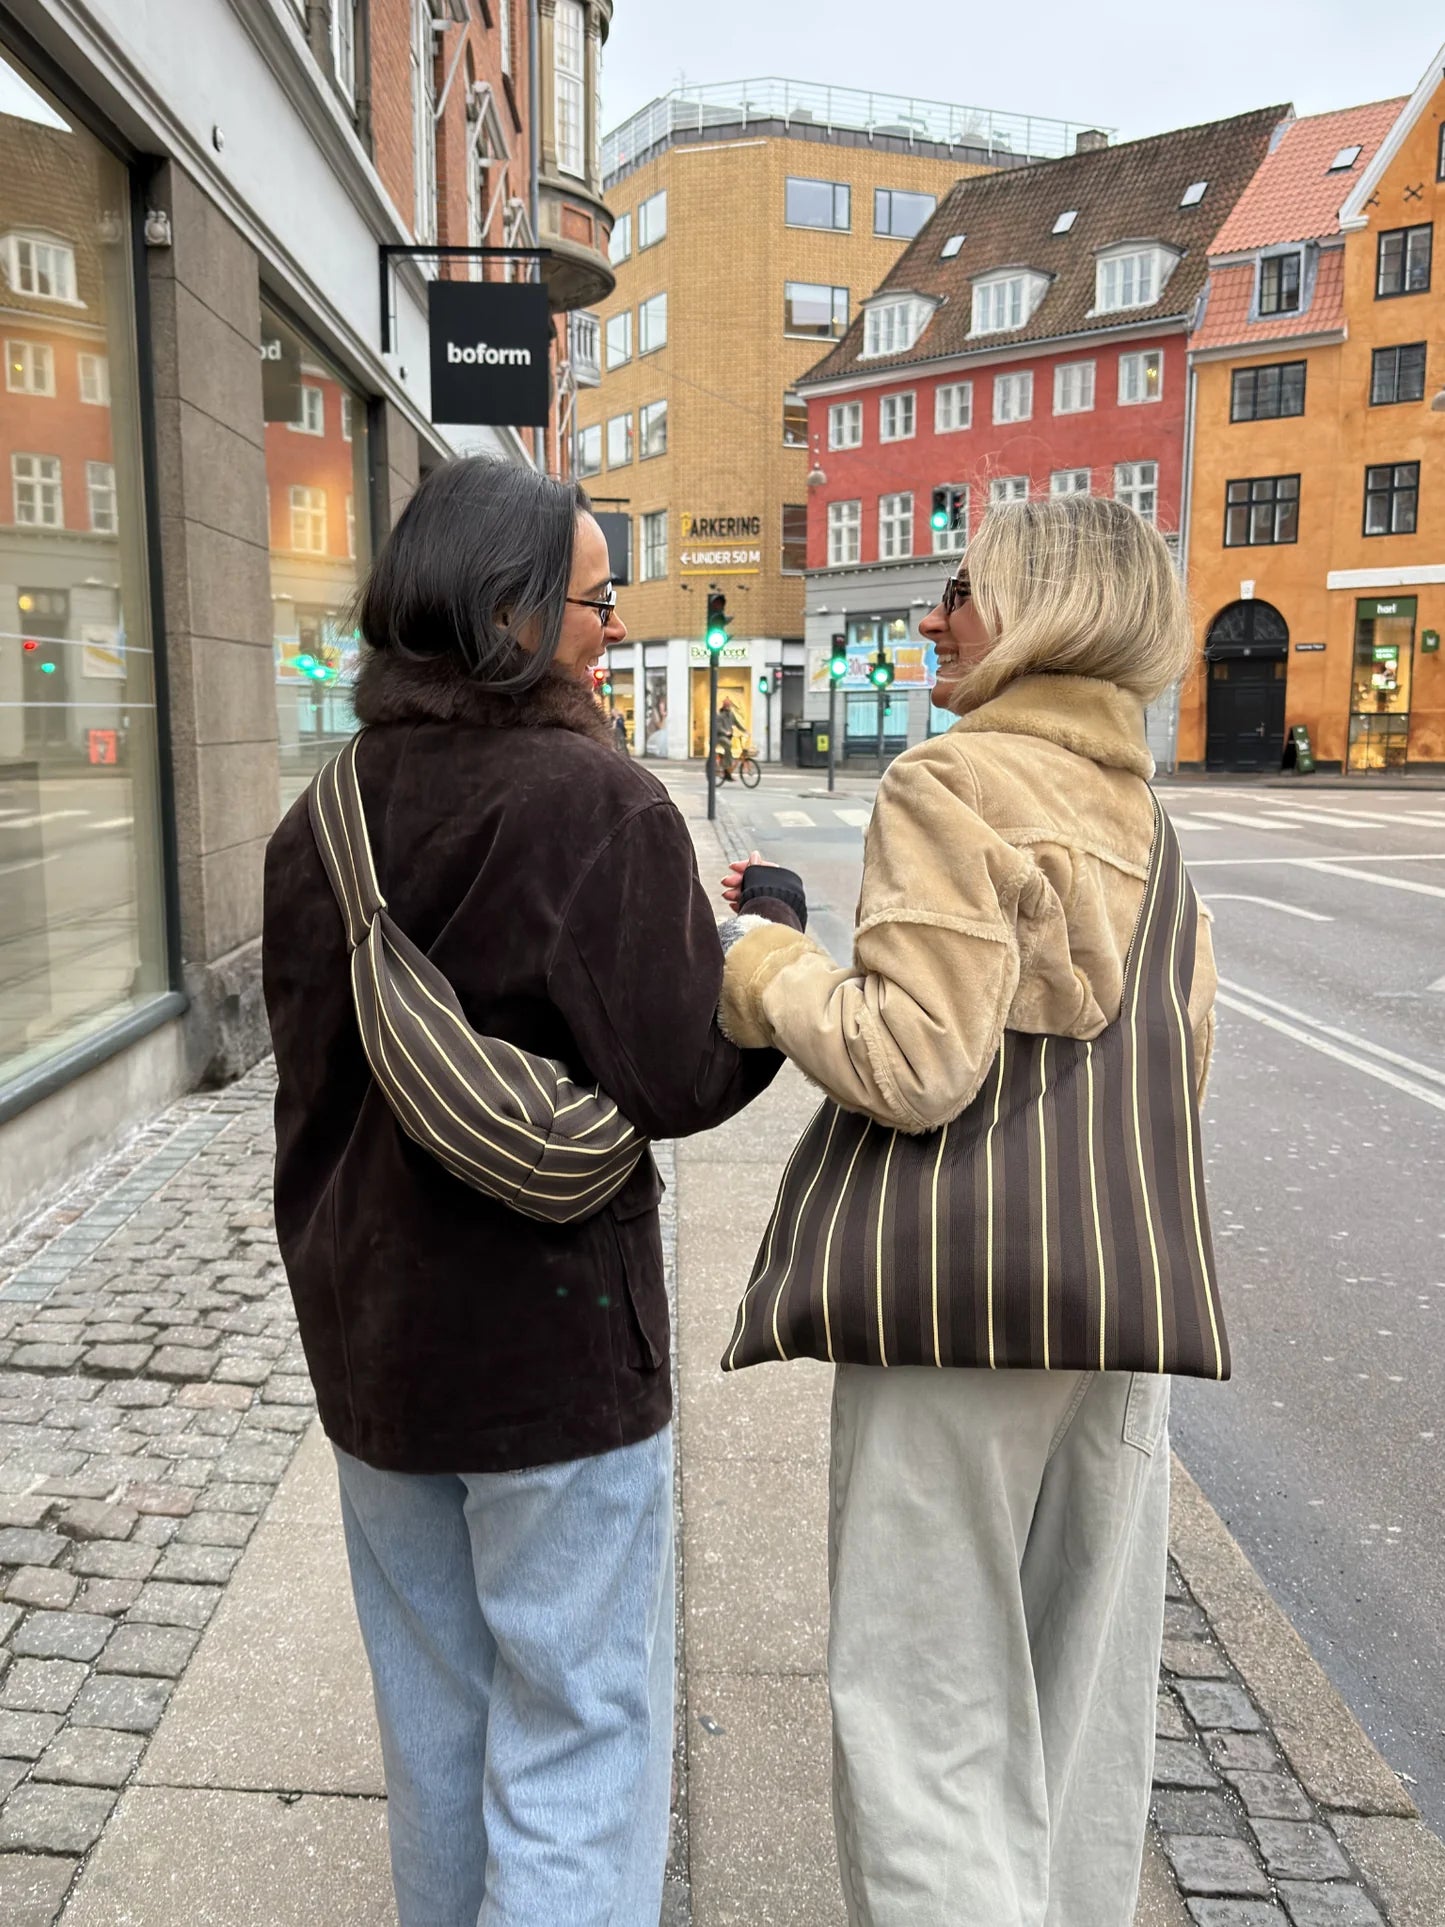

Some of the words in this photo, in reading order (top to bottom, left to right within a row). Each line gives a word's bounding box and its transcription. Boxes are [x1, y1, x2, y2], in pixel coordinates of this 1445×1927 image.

[447, 341, 531, 365] boform
[680, 512, 760, 537] PARKERING
[691, 551, 731, 564] UNDER
[732, 550, 748, 564] 50
[749, 549, 760, 563] M
